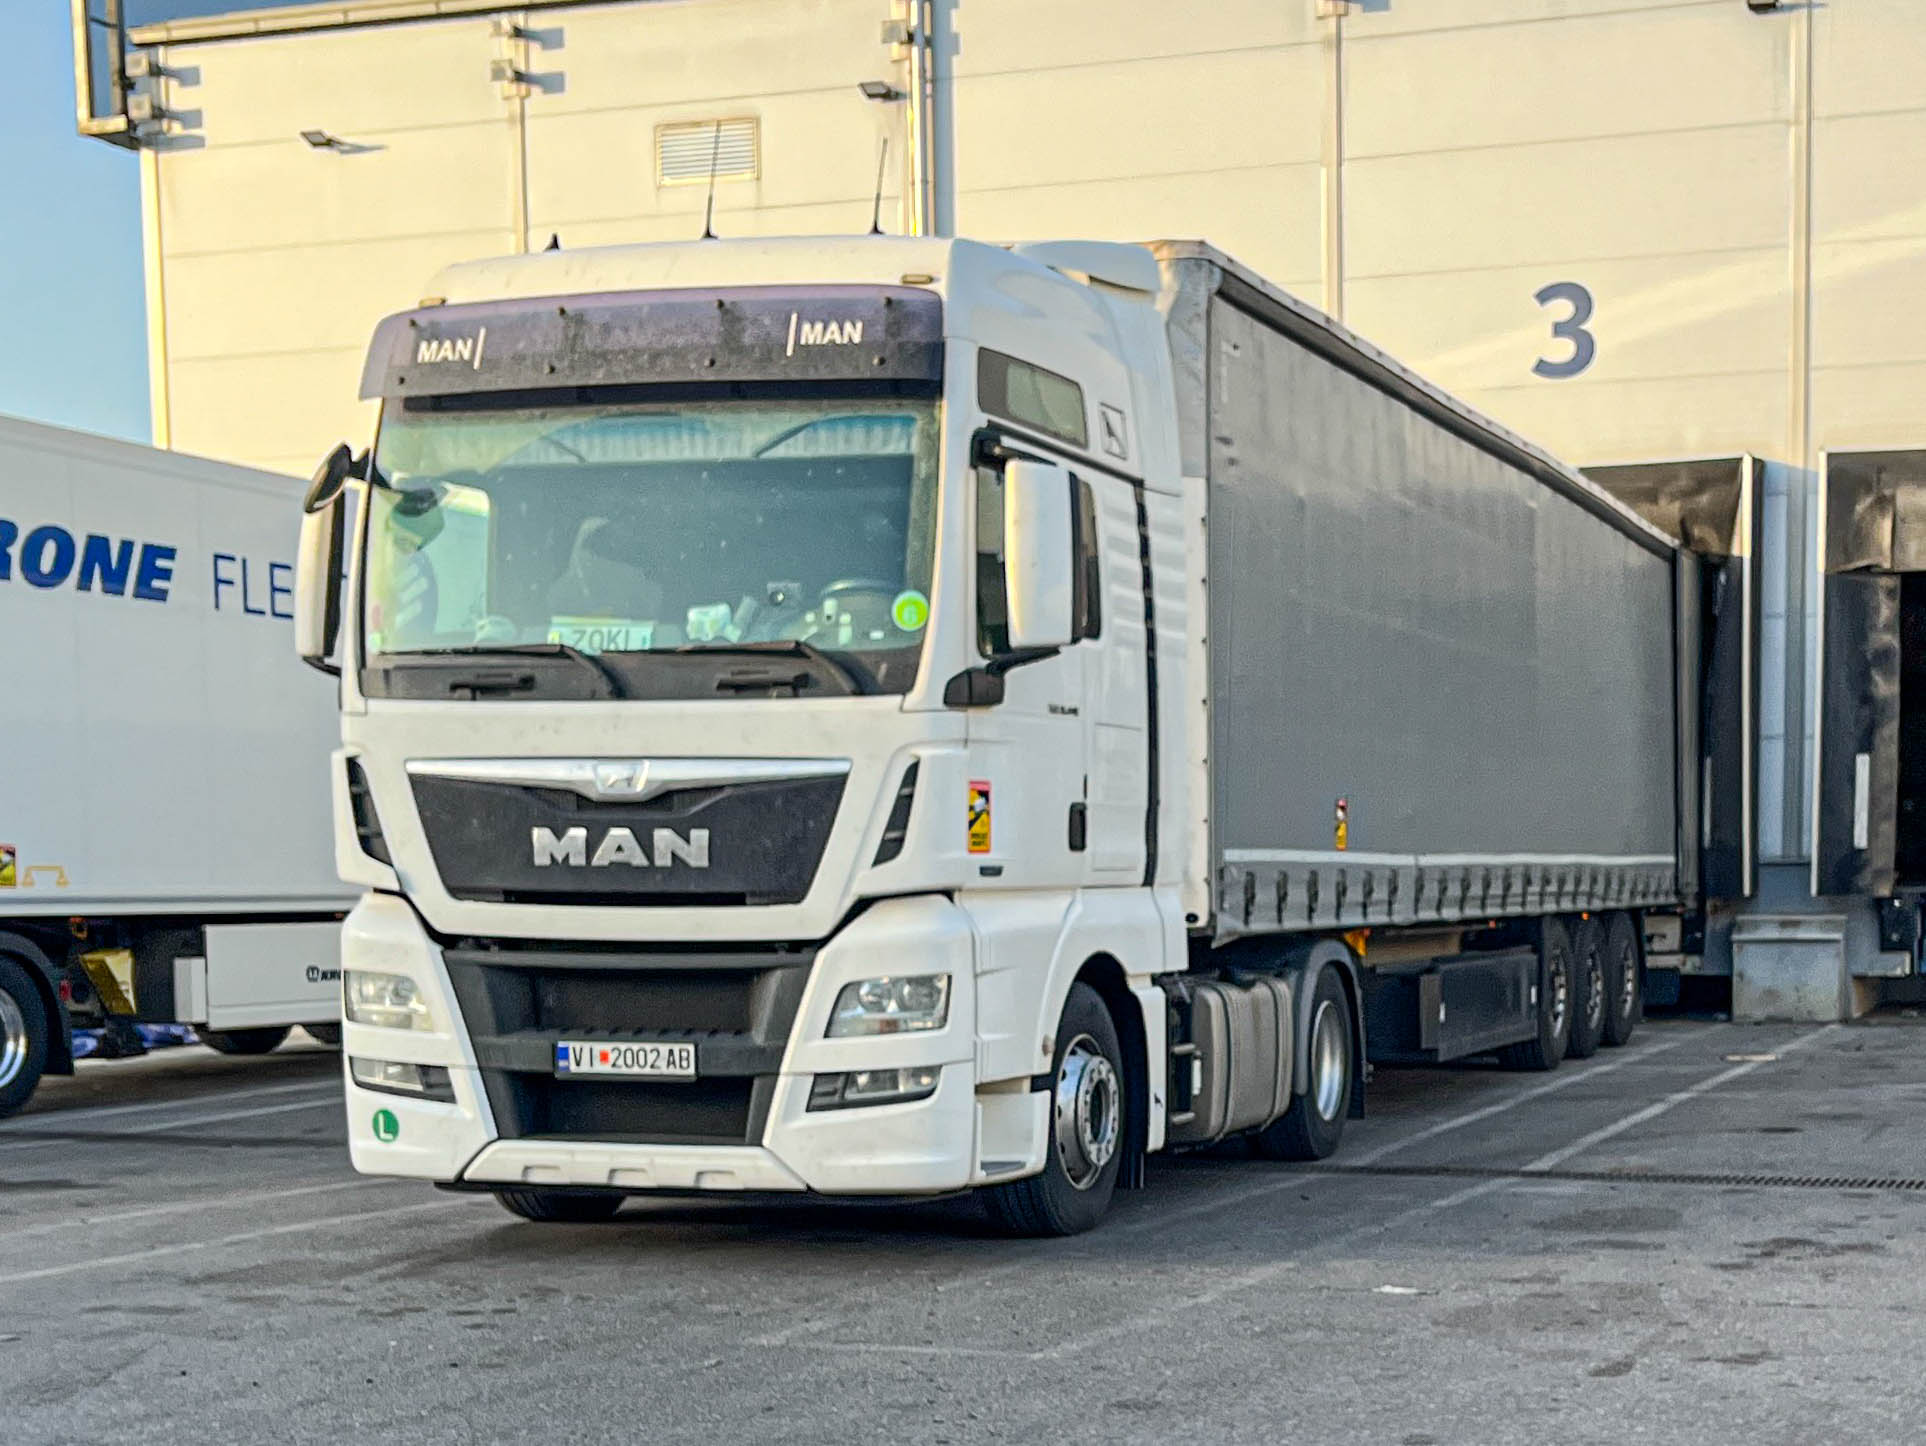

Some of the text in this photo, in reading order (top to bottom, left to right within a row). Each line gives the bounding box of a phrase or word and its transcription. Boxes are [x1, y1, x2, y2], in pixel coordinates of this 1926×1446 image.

[800, 321, 863, 345] MAN
[1533, 282, 1594, 378] 3
[417, 338, 473, 363] MAN
[532, 827, 710, 867] MAN
[572, 1046, 593, 1067] VI
[379, 1112, 394, 1139] L
